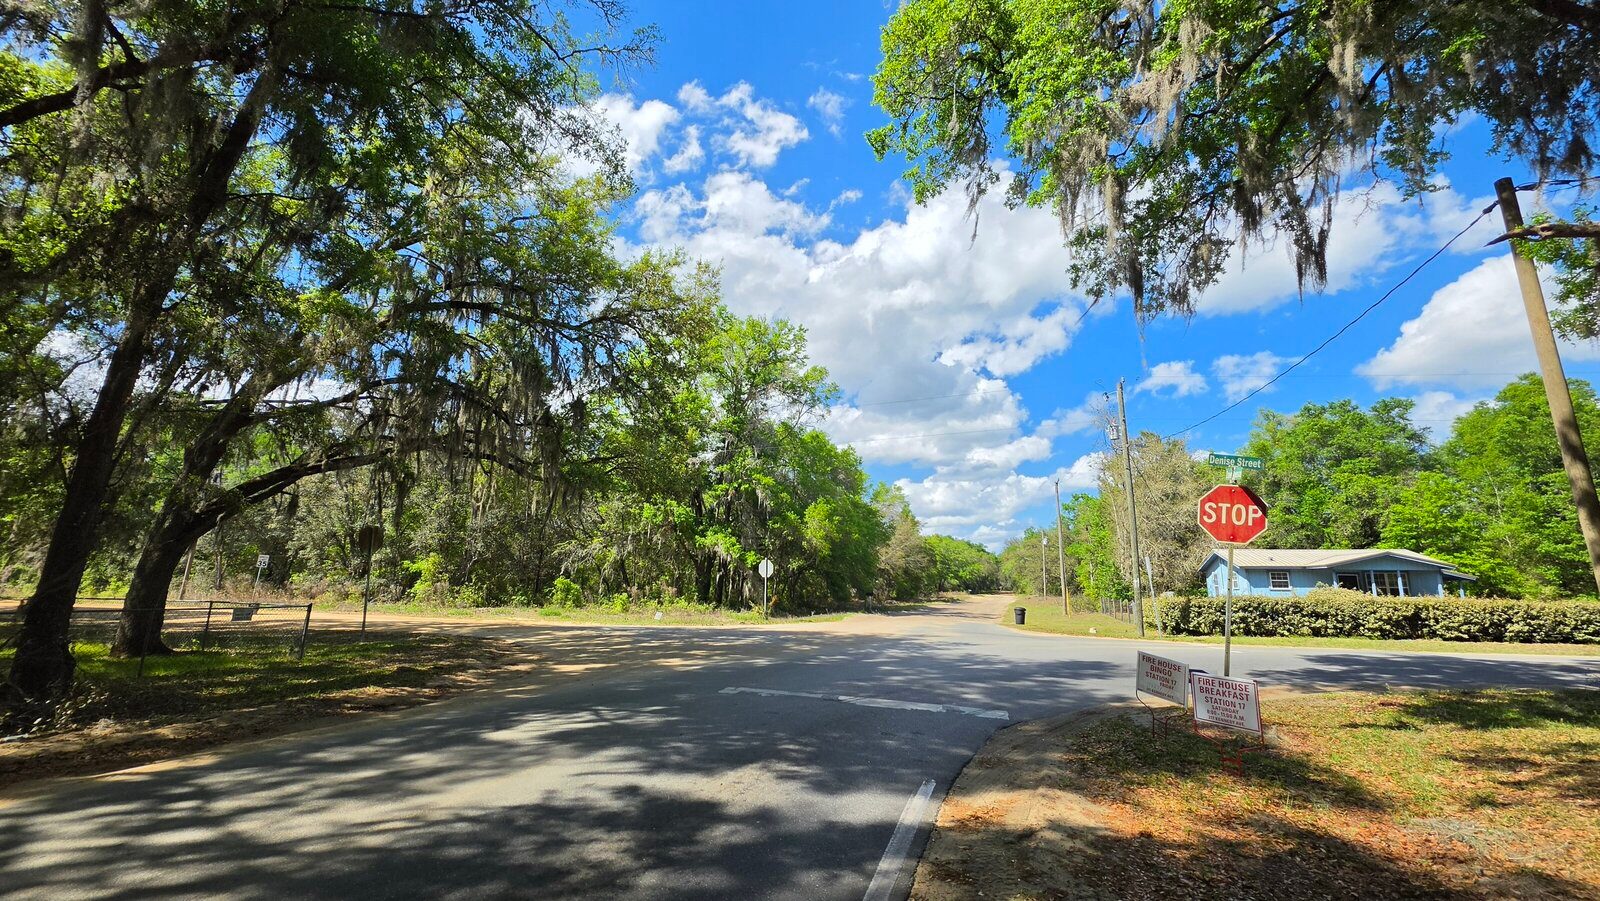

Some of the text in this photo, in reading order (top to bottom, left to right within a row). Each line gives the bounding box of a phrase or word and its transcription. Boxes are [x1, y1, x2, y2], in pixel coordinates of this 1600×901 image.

[1209, 455, 1261, 468] Denise Street
[1202, 502, 1263, 526] STOP
[1142, 655, 1182, 672] FIRE HOUSE
[1145, 671, 1169, 684] STATION
[1150, 665, 1172, 677] BINGO
[1198, 677, 1250, 692] FIRE HOUSE
[1199, 686, 1250, 702] BREAKFAST
[1204, 696, 1236, 708] STATION
[1211, 705, 1239, 714] SATURDAY
